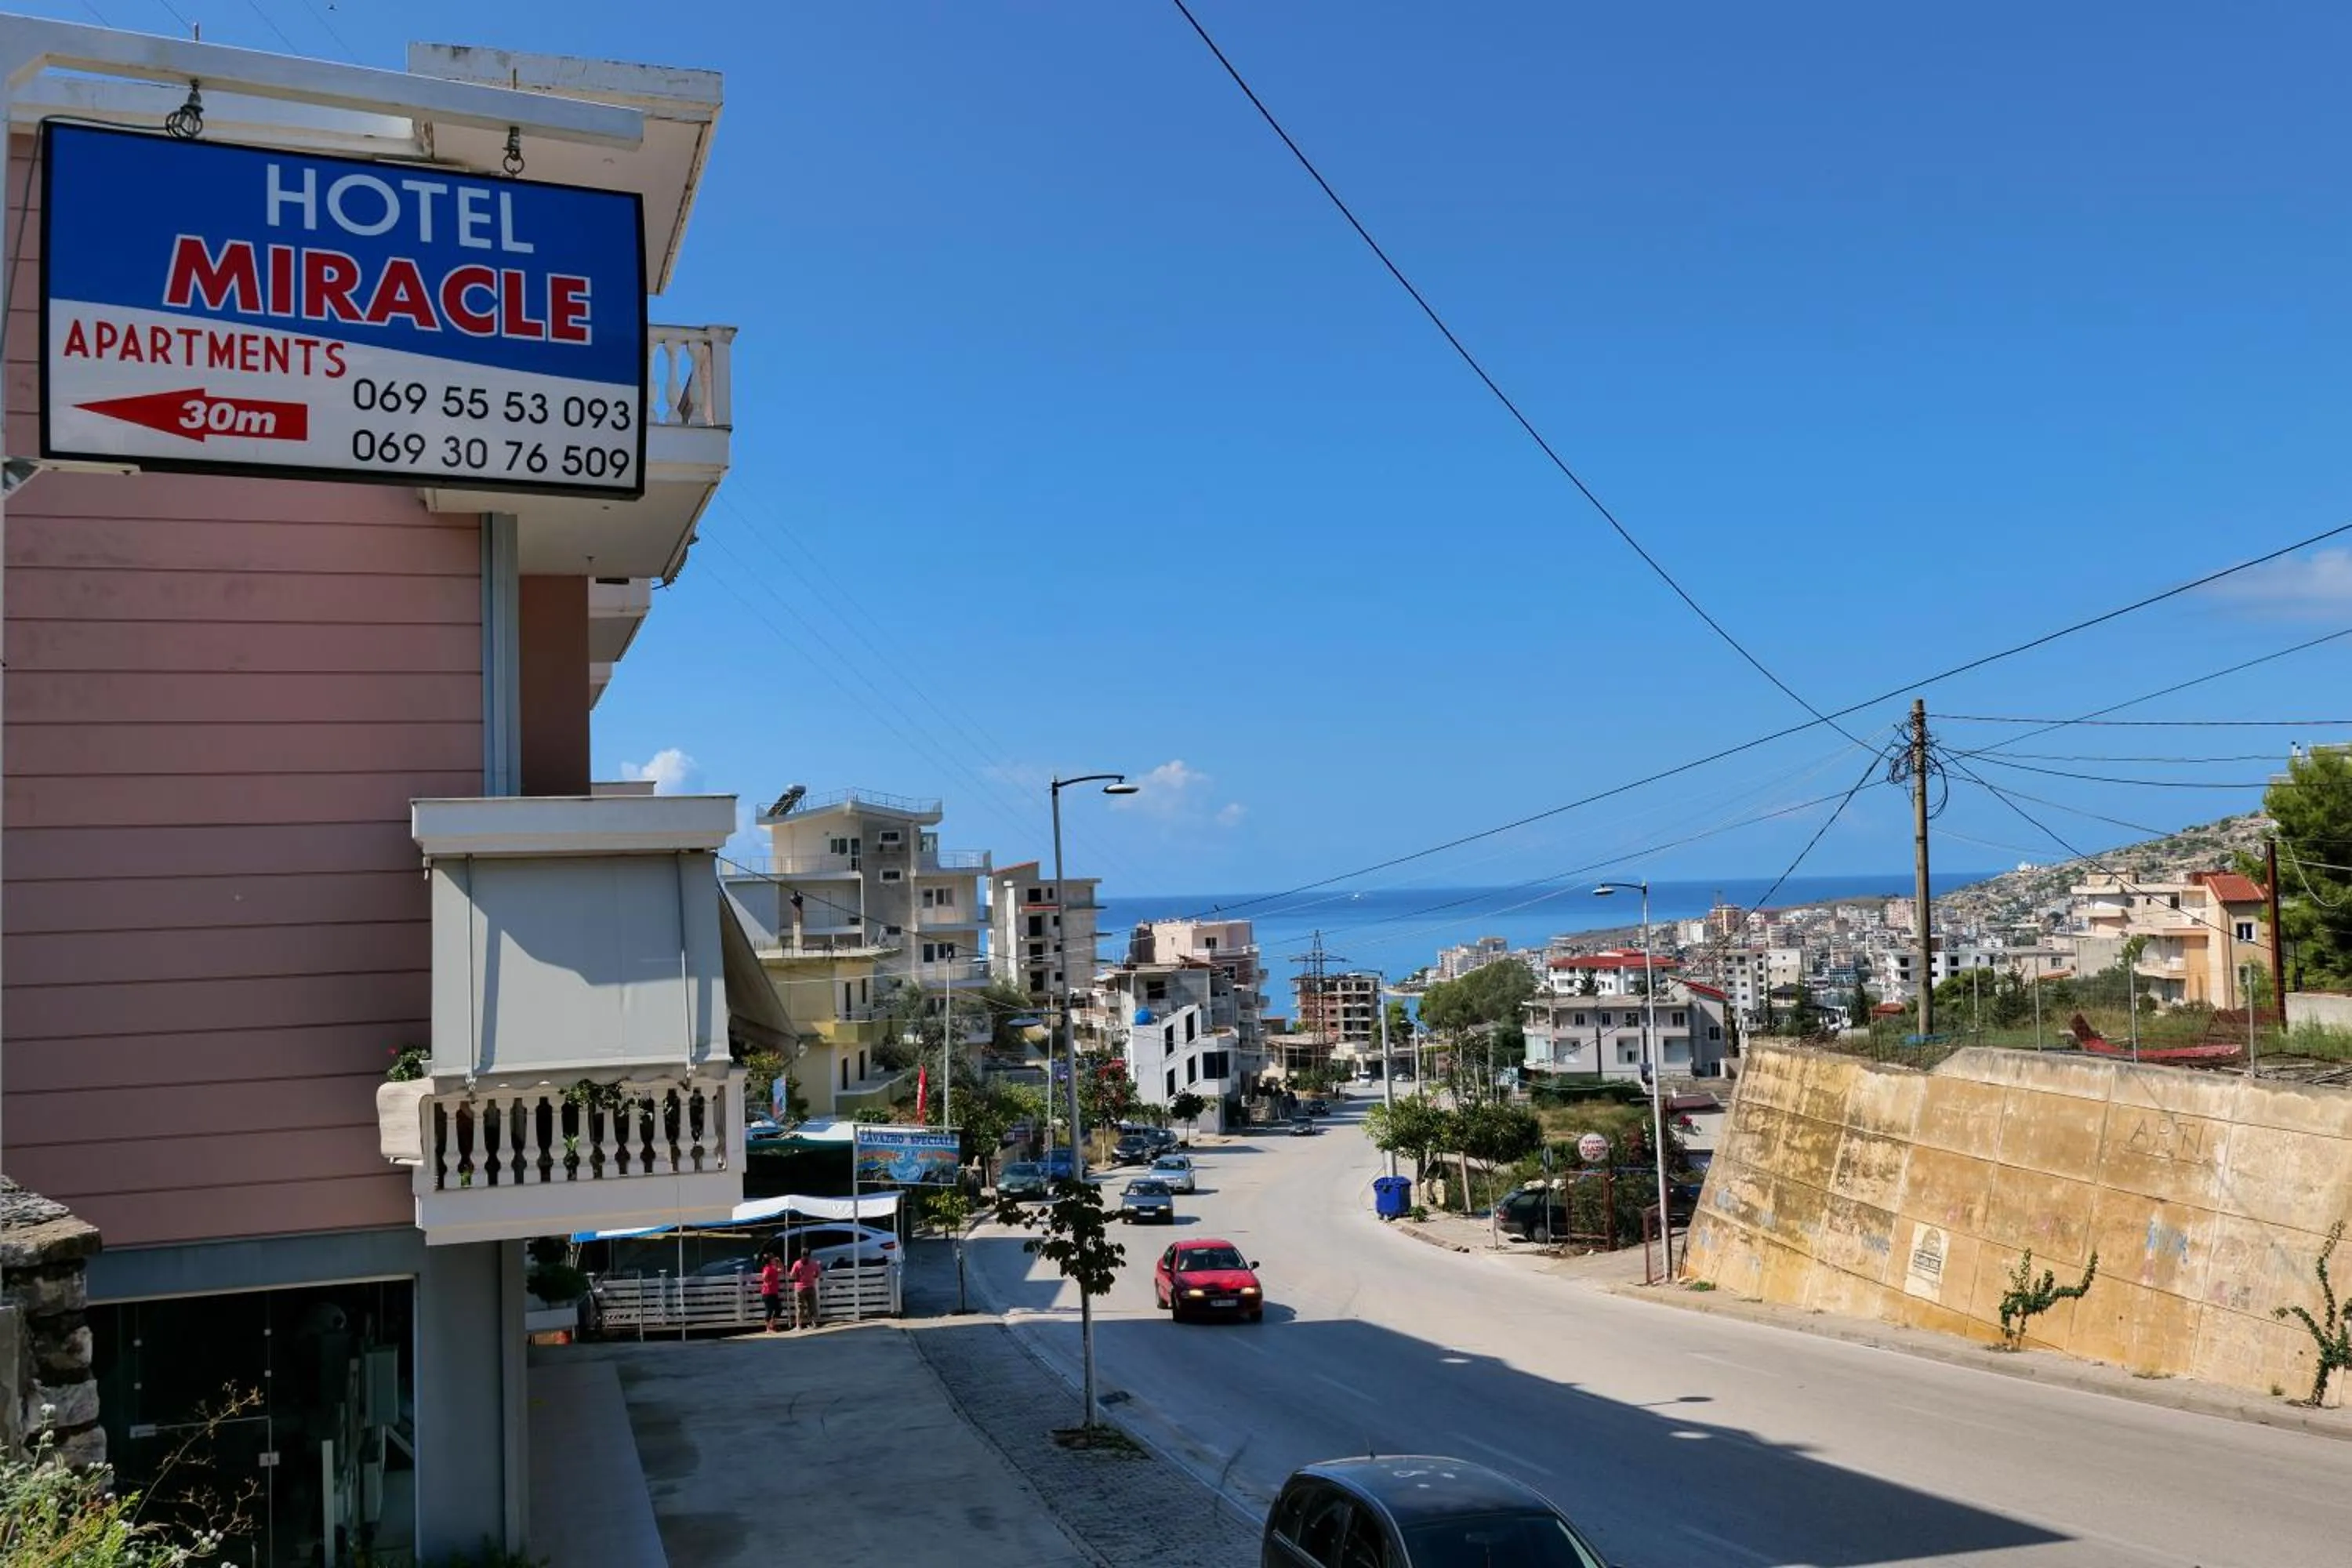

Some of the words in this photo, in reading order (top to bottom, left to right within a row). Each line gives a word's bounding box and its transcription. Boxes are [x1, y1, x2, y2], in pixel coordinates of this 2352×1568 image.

[267, 164, 534, 253] HOTEL
[162, 234, 592, 346] MIRACLE
[64, 319, 347, 378] APARTMENTS
[179, 400, 276, 434] 30m
[354, 378, 427, 414] 069
[441, 387, 489, 419] 55
[503, 392, 549, 424] 53
[564, 397, 630, 430] 093
[353, 430, 426, 464] 069
[441, 436, 488, 469] 30
[505, 440, 548, 474] 76
[561, 445, 630, 479] 509
